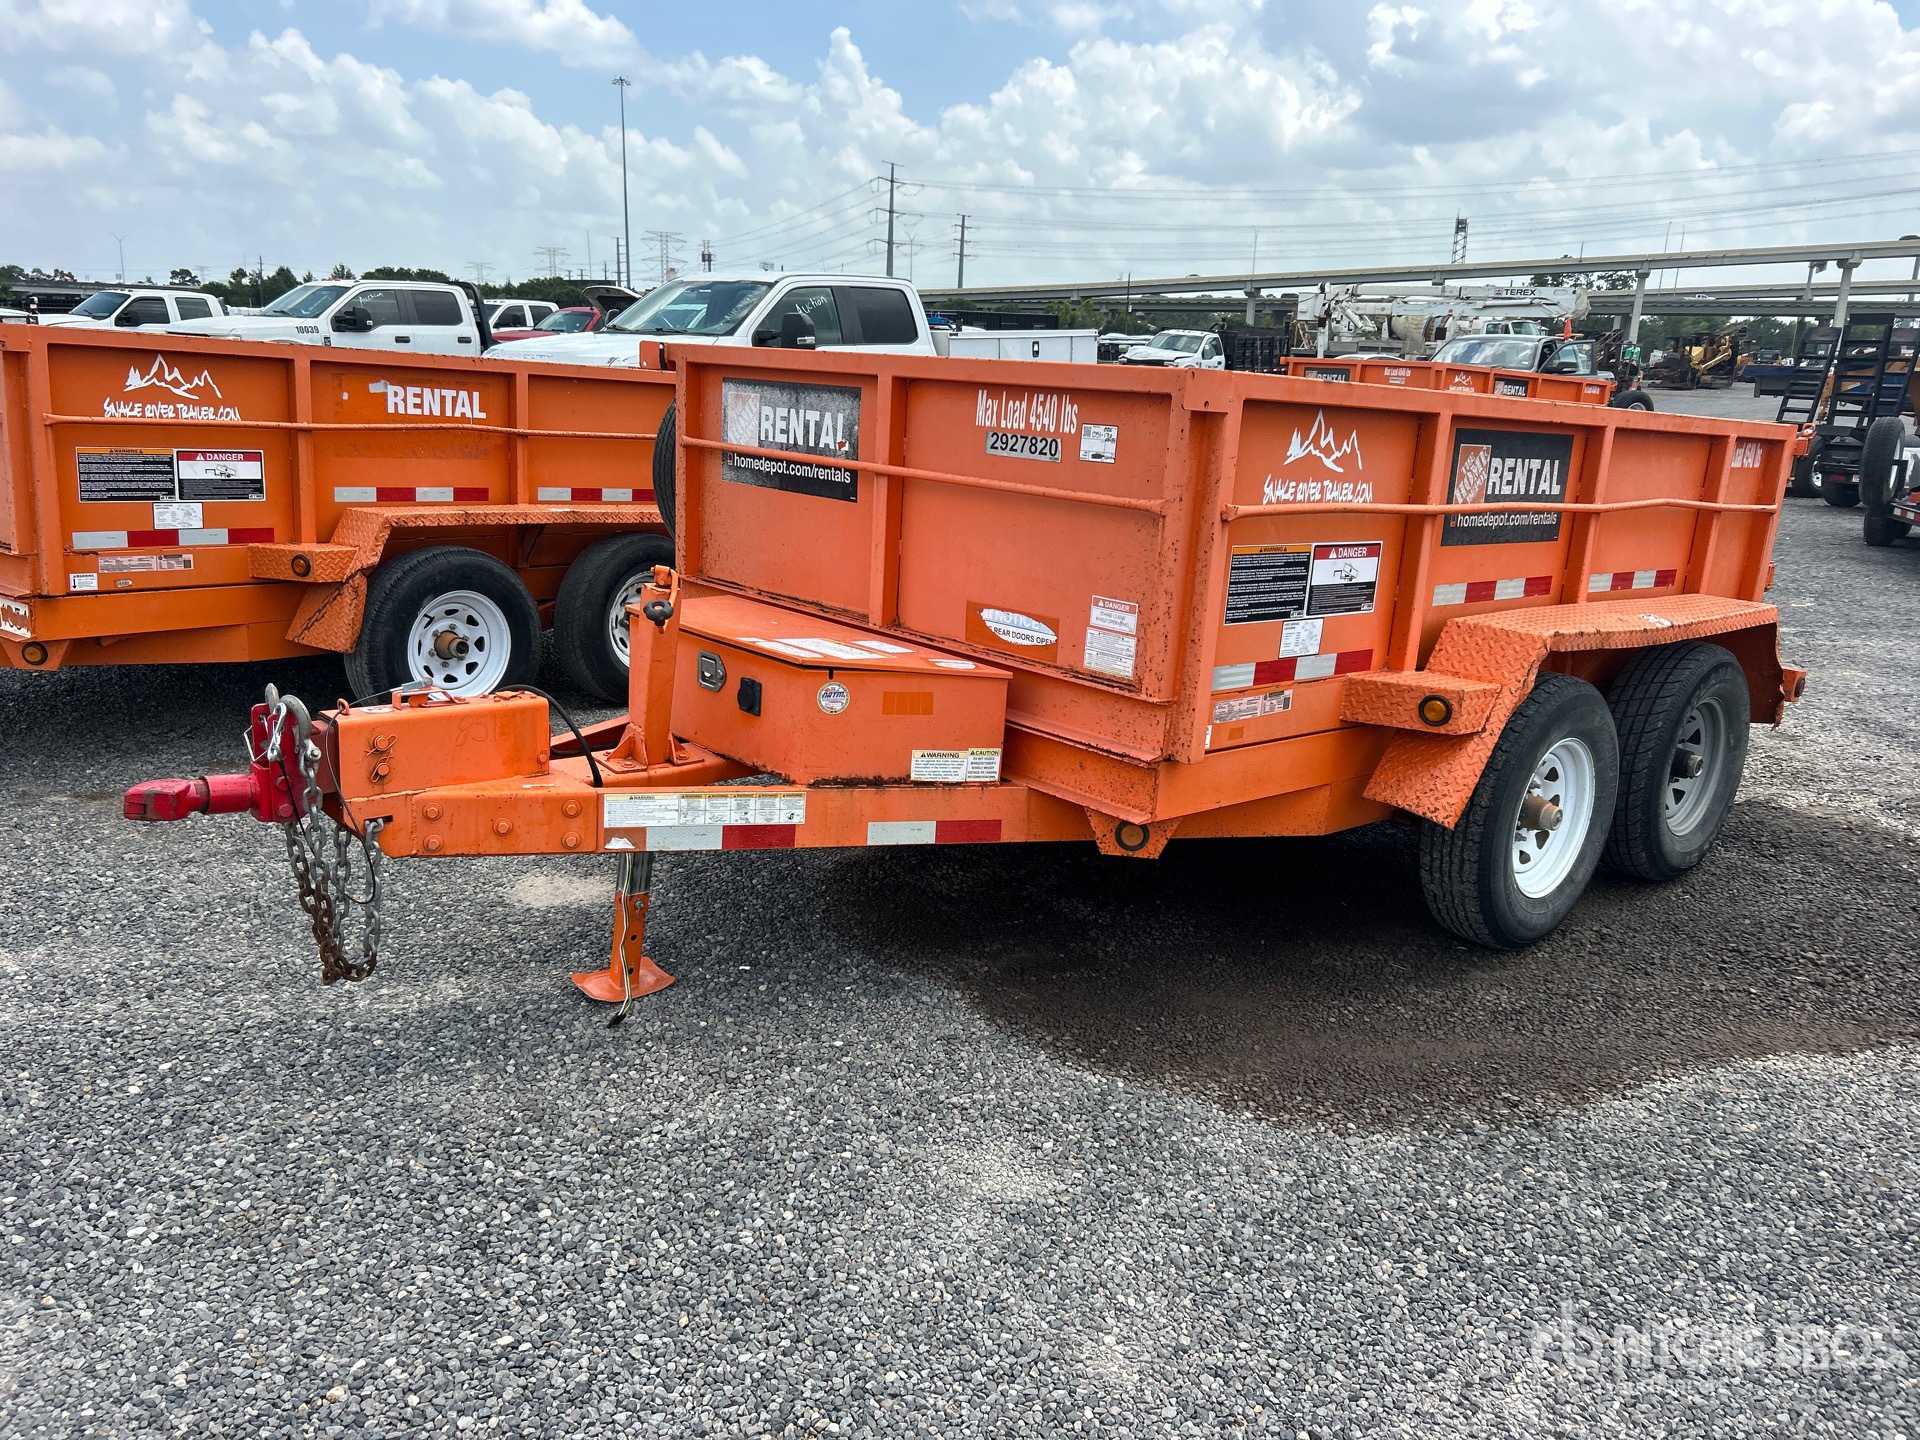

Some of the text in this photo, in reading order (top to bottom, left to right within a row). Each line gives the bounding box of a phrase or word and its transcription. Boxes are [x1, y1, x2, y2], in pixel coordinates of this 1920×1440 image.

[295, 325, 320, 335] 10039
[387, 384, 487, 419] RENTAL
[1504, 385, 1526, 397] RENTAL
[103, 397, 142, 419] SNAKE
[145, 401, 176, 419] RIVER
[975, 389, 1079, 435] Max Load 4540 lbs
[760, 405, 850, 452] RENTAL
[989, 431, 1060, 458] 2927820
[206, 453, 245, 462] DANGER
[734, 454, 851, 484] homedepot.com/rentals
[1486, 457, 1561, 495] RENTAL
[1262, 473, 1297, 506] SNAKE
[1296, 477, 1322, 504] RIVER
[1456, 511, 1559, 530] homedepot.com/rentals
[1337, 547, 1368, 558] DANGER
[1104, 601, 1130, 613] DANGER
[994, 608, 1041, 630] NOTICE
[993, 626, 1011, 638] REAR
[1011, 631, 1035, 643] DOORS
